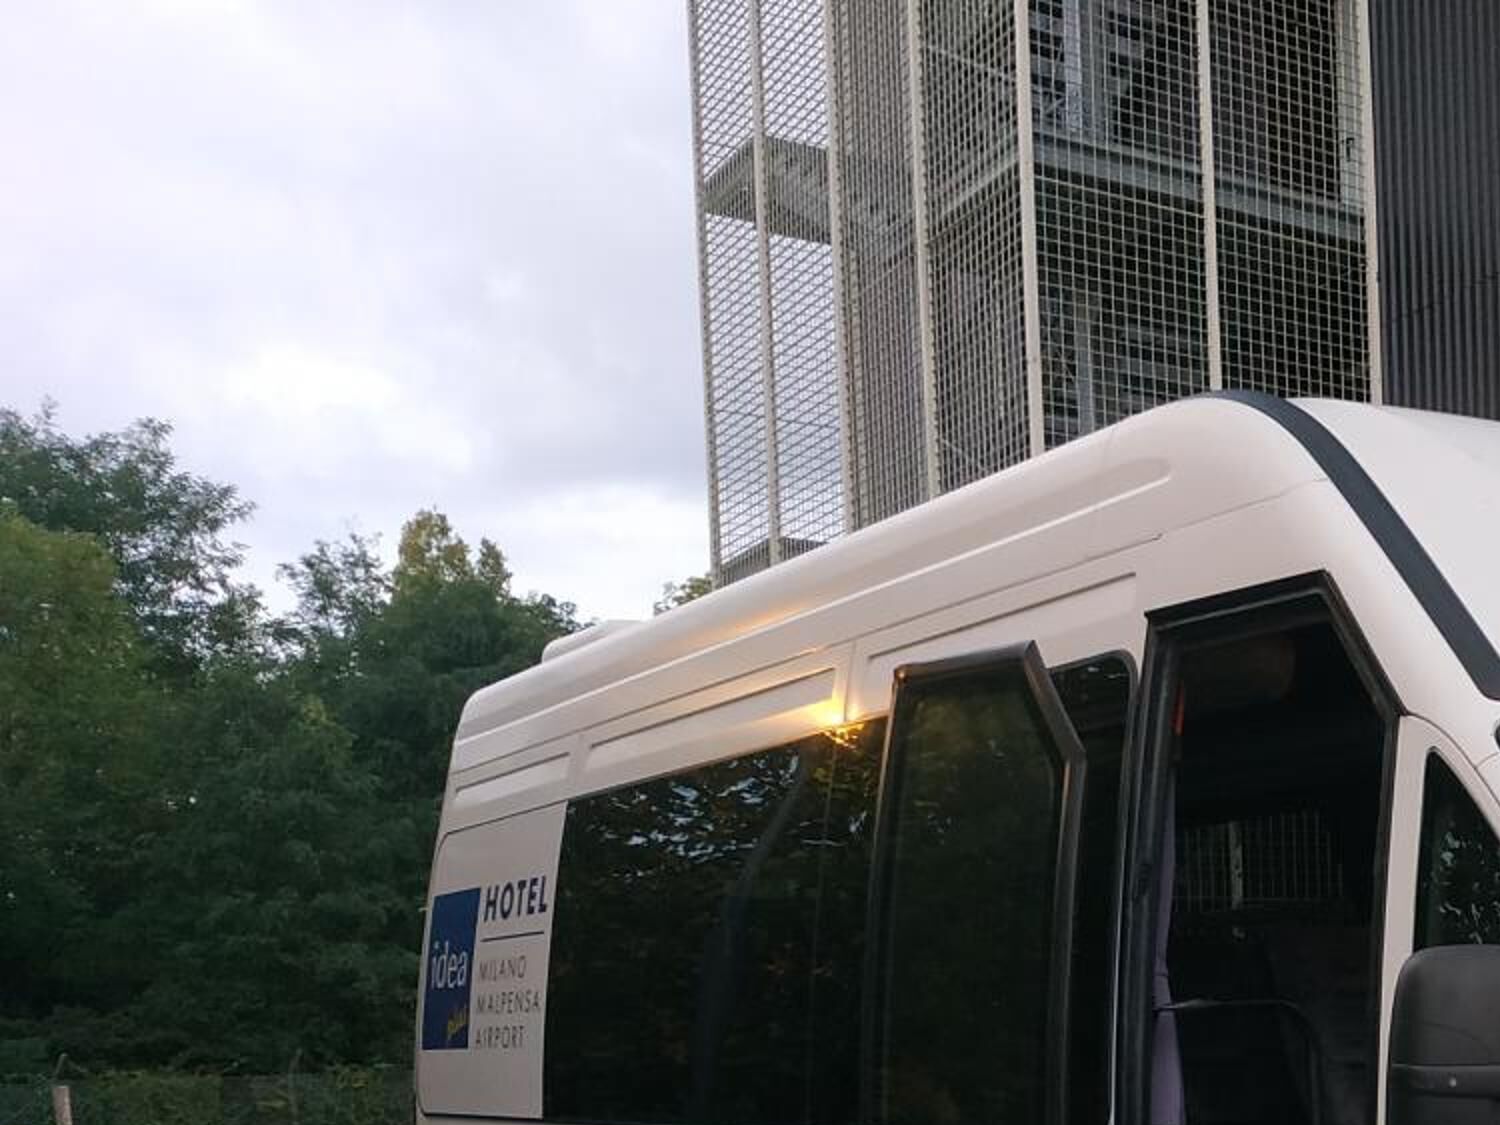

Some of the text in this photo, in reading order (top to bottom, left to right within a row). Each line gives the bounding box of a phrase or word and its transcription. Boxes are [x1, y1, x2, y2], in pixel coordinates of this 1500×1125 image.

[483, 875, 547, 922] HOTEL
[430, 941, 467, 989] idea
[478, 955, 526, 982] MILANO
[476, 990, 541, 1015] MALPENSA
[475, 1025, 525, 1050] AIRPORT
